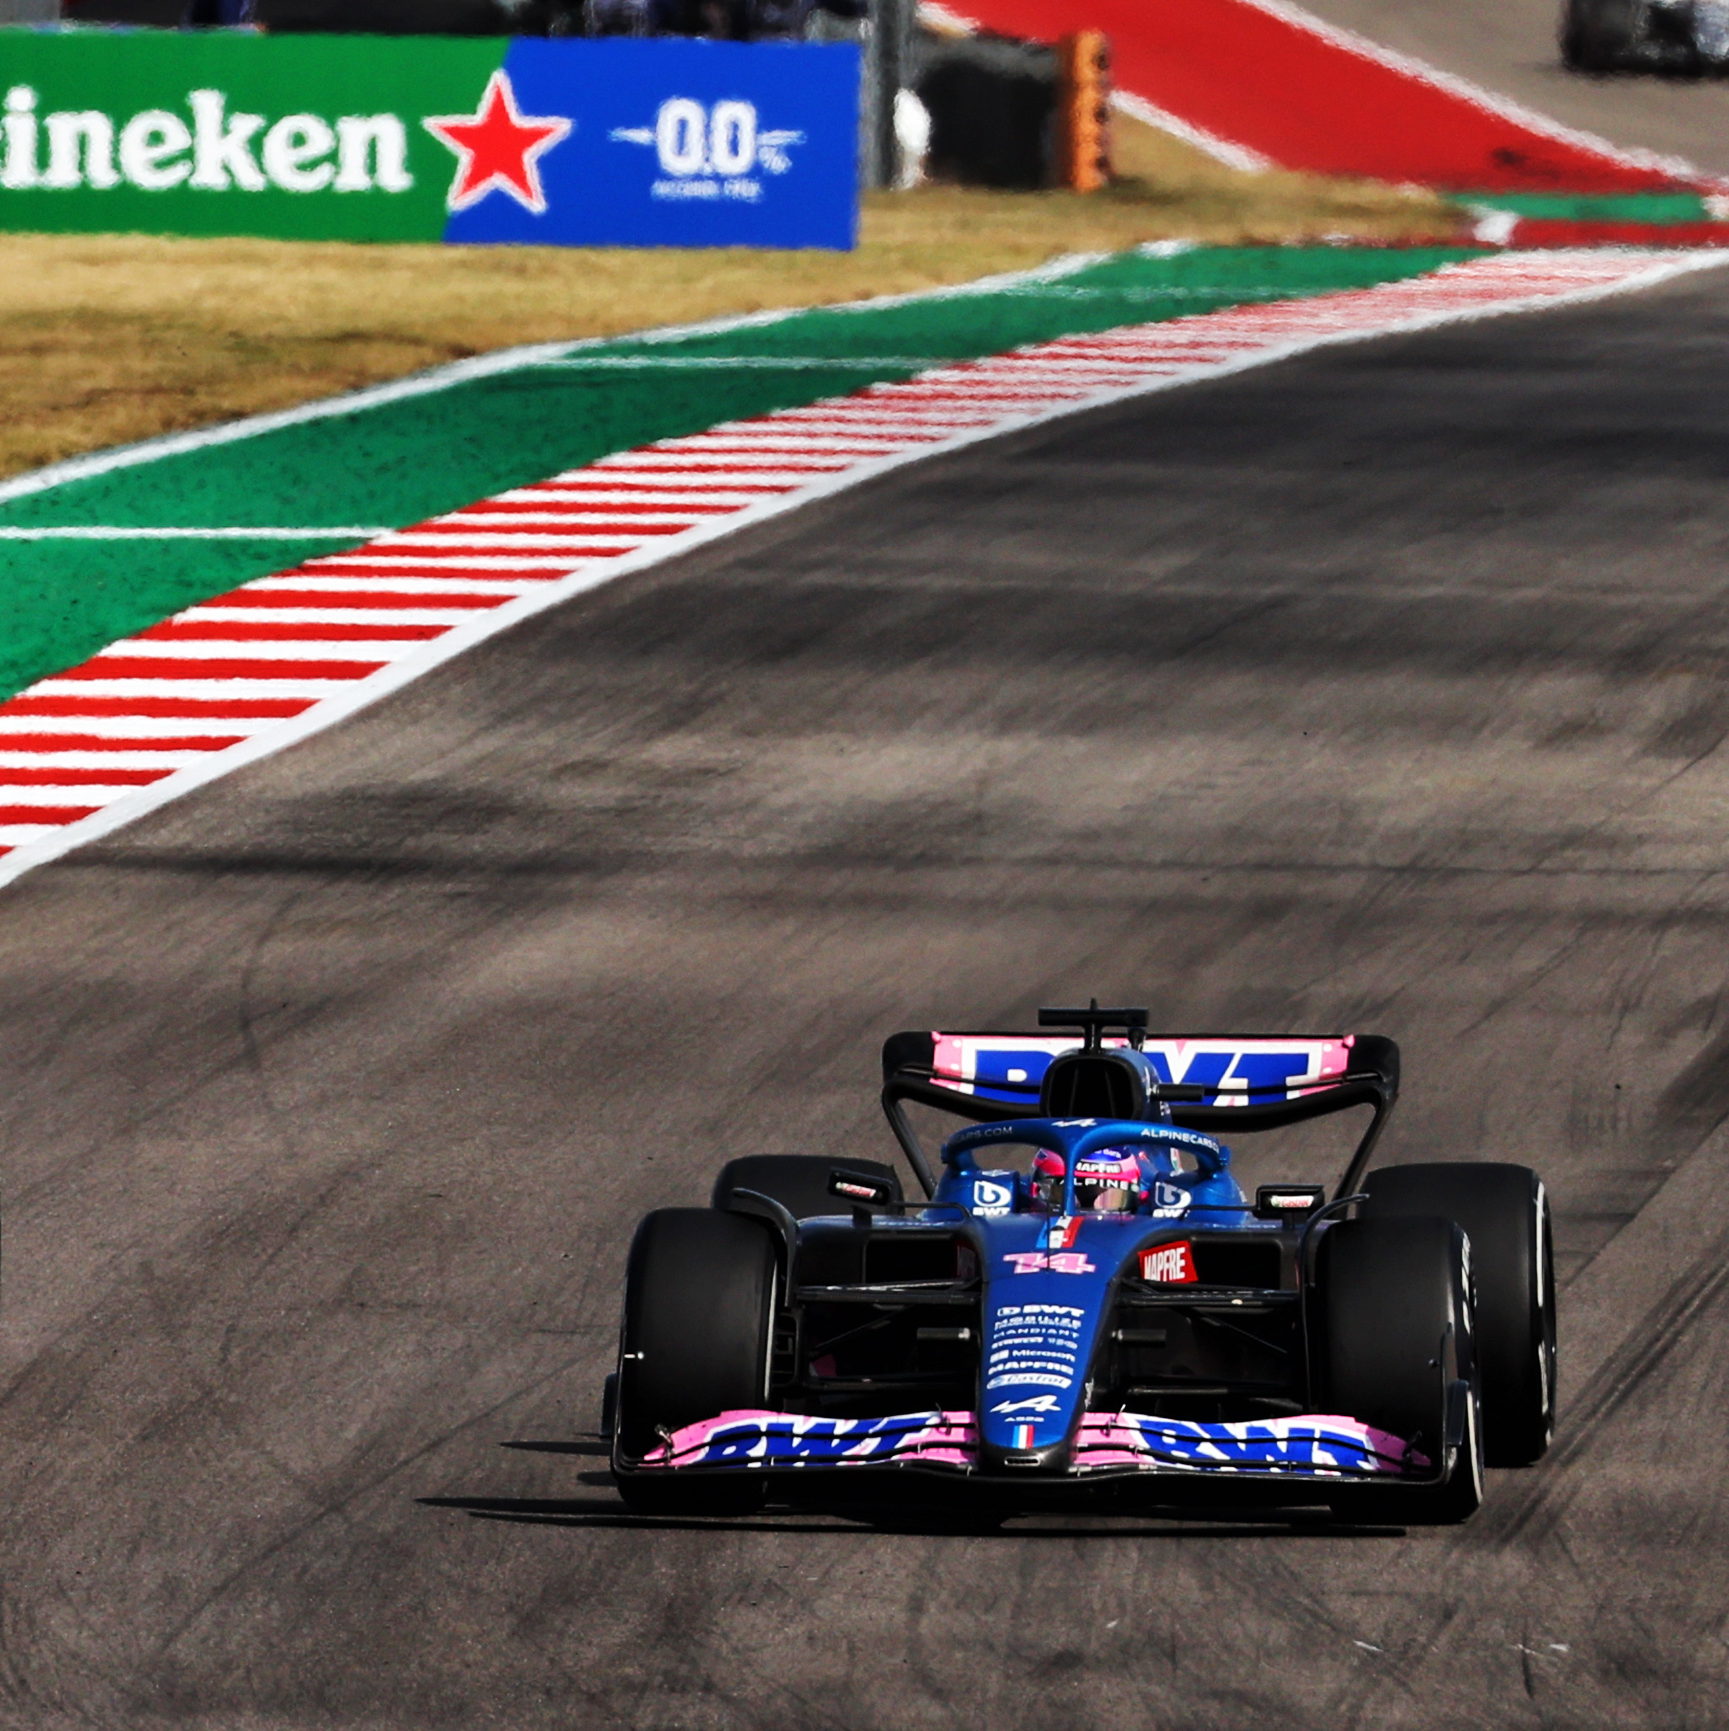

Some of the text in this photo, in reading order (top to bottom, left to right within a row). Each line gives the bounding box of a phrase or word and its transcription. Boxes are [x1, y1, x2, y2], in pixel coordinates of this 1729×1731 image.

[1003, 1252, 1097, 1274] 14
[1143, 1246, 1186, 1282] MAPFRE
[1022, 1304, 1085, 1317] BWT
